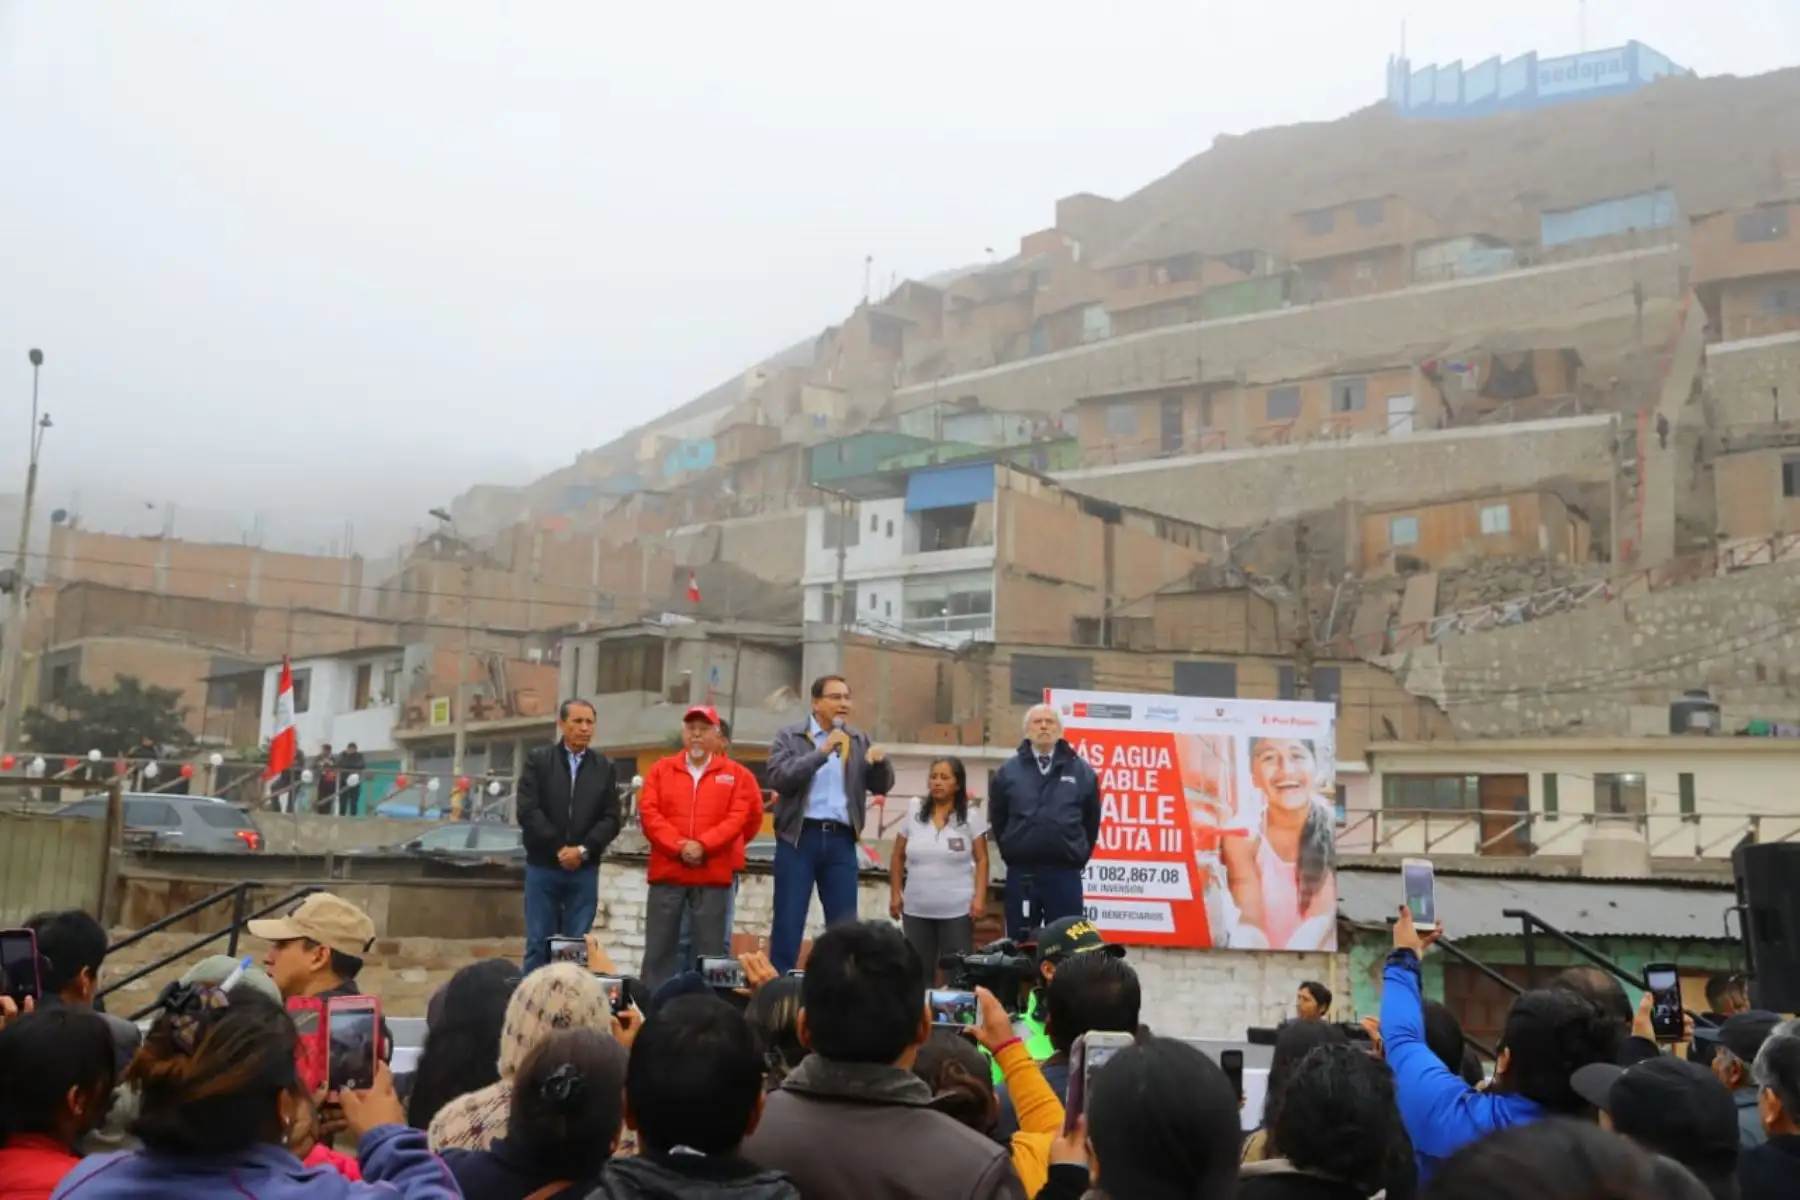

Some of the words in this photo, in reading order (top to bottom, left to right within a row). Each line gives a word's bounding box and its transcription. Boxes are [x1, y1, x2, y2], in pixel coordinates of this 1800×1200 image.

[1069, 738, 1104, 767] ÁS
[1111, 744, 1172, 770] AGUA
[1100, 793, 1176, 826] ALLE
[1096, 826, 1152, 852] AUTA
[1159, 828, 1182, 853] III
[1082, 905, 1098, 921] 40
[1101, 909, 1165, 921] BENEFICIARIOS
